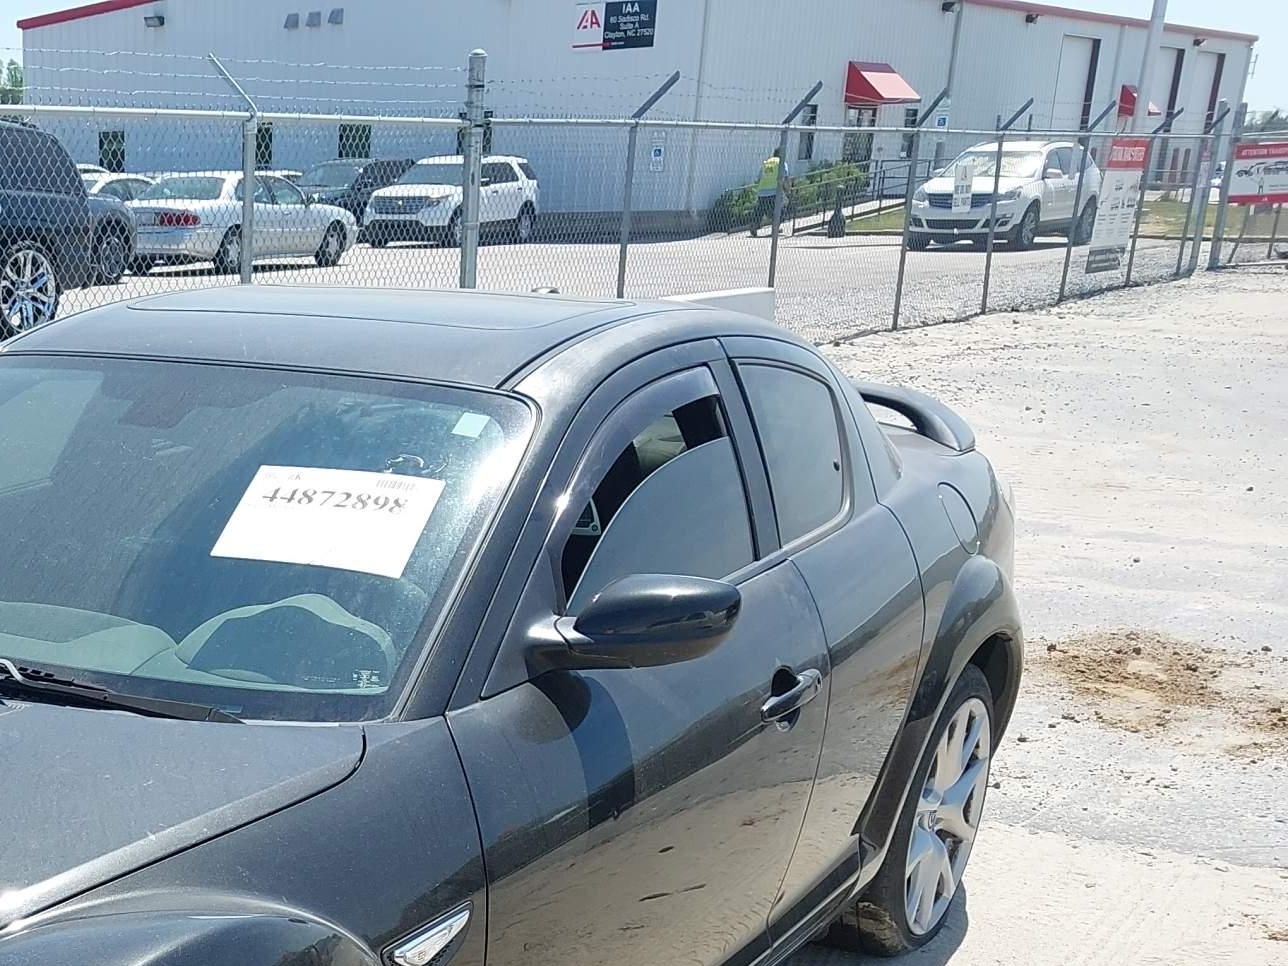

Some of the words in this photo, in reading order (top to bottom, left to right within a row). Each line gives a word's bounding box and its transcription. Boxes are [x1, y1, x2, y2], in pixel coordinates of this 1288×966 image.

[622, 2, 640, 13] IAA
[619, 22, 633, 30] Suite
[626, 29, 636, 37] NC
[262, 487, 409, 514] 44872898
